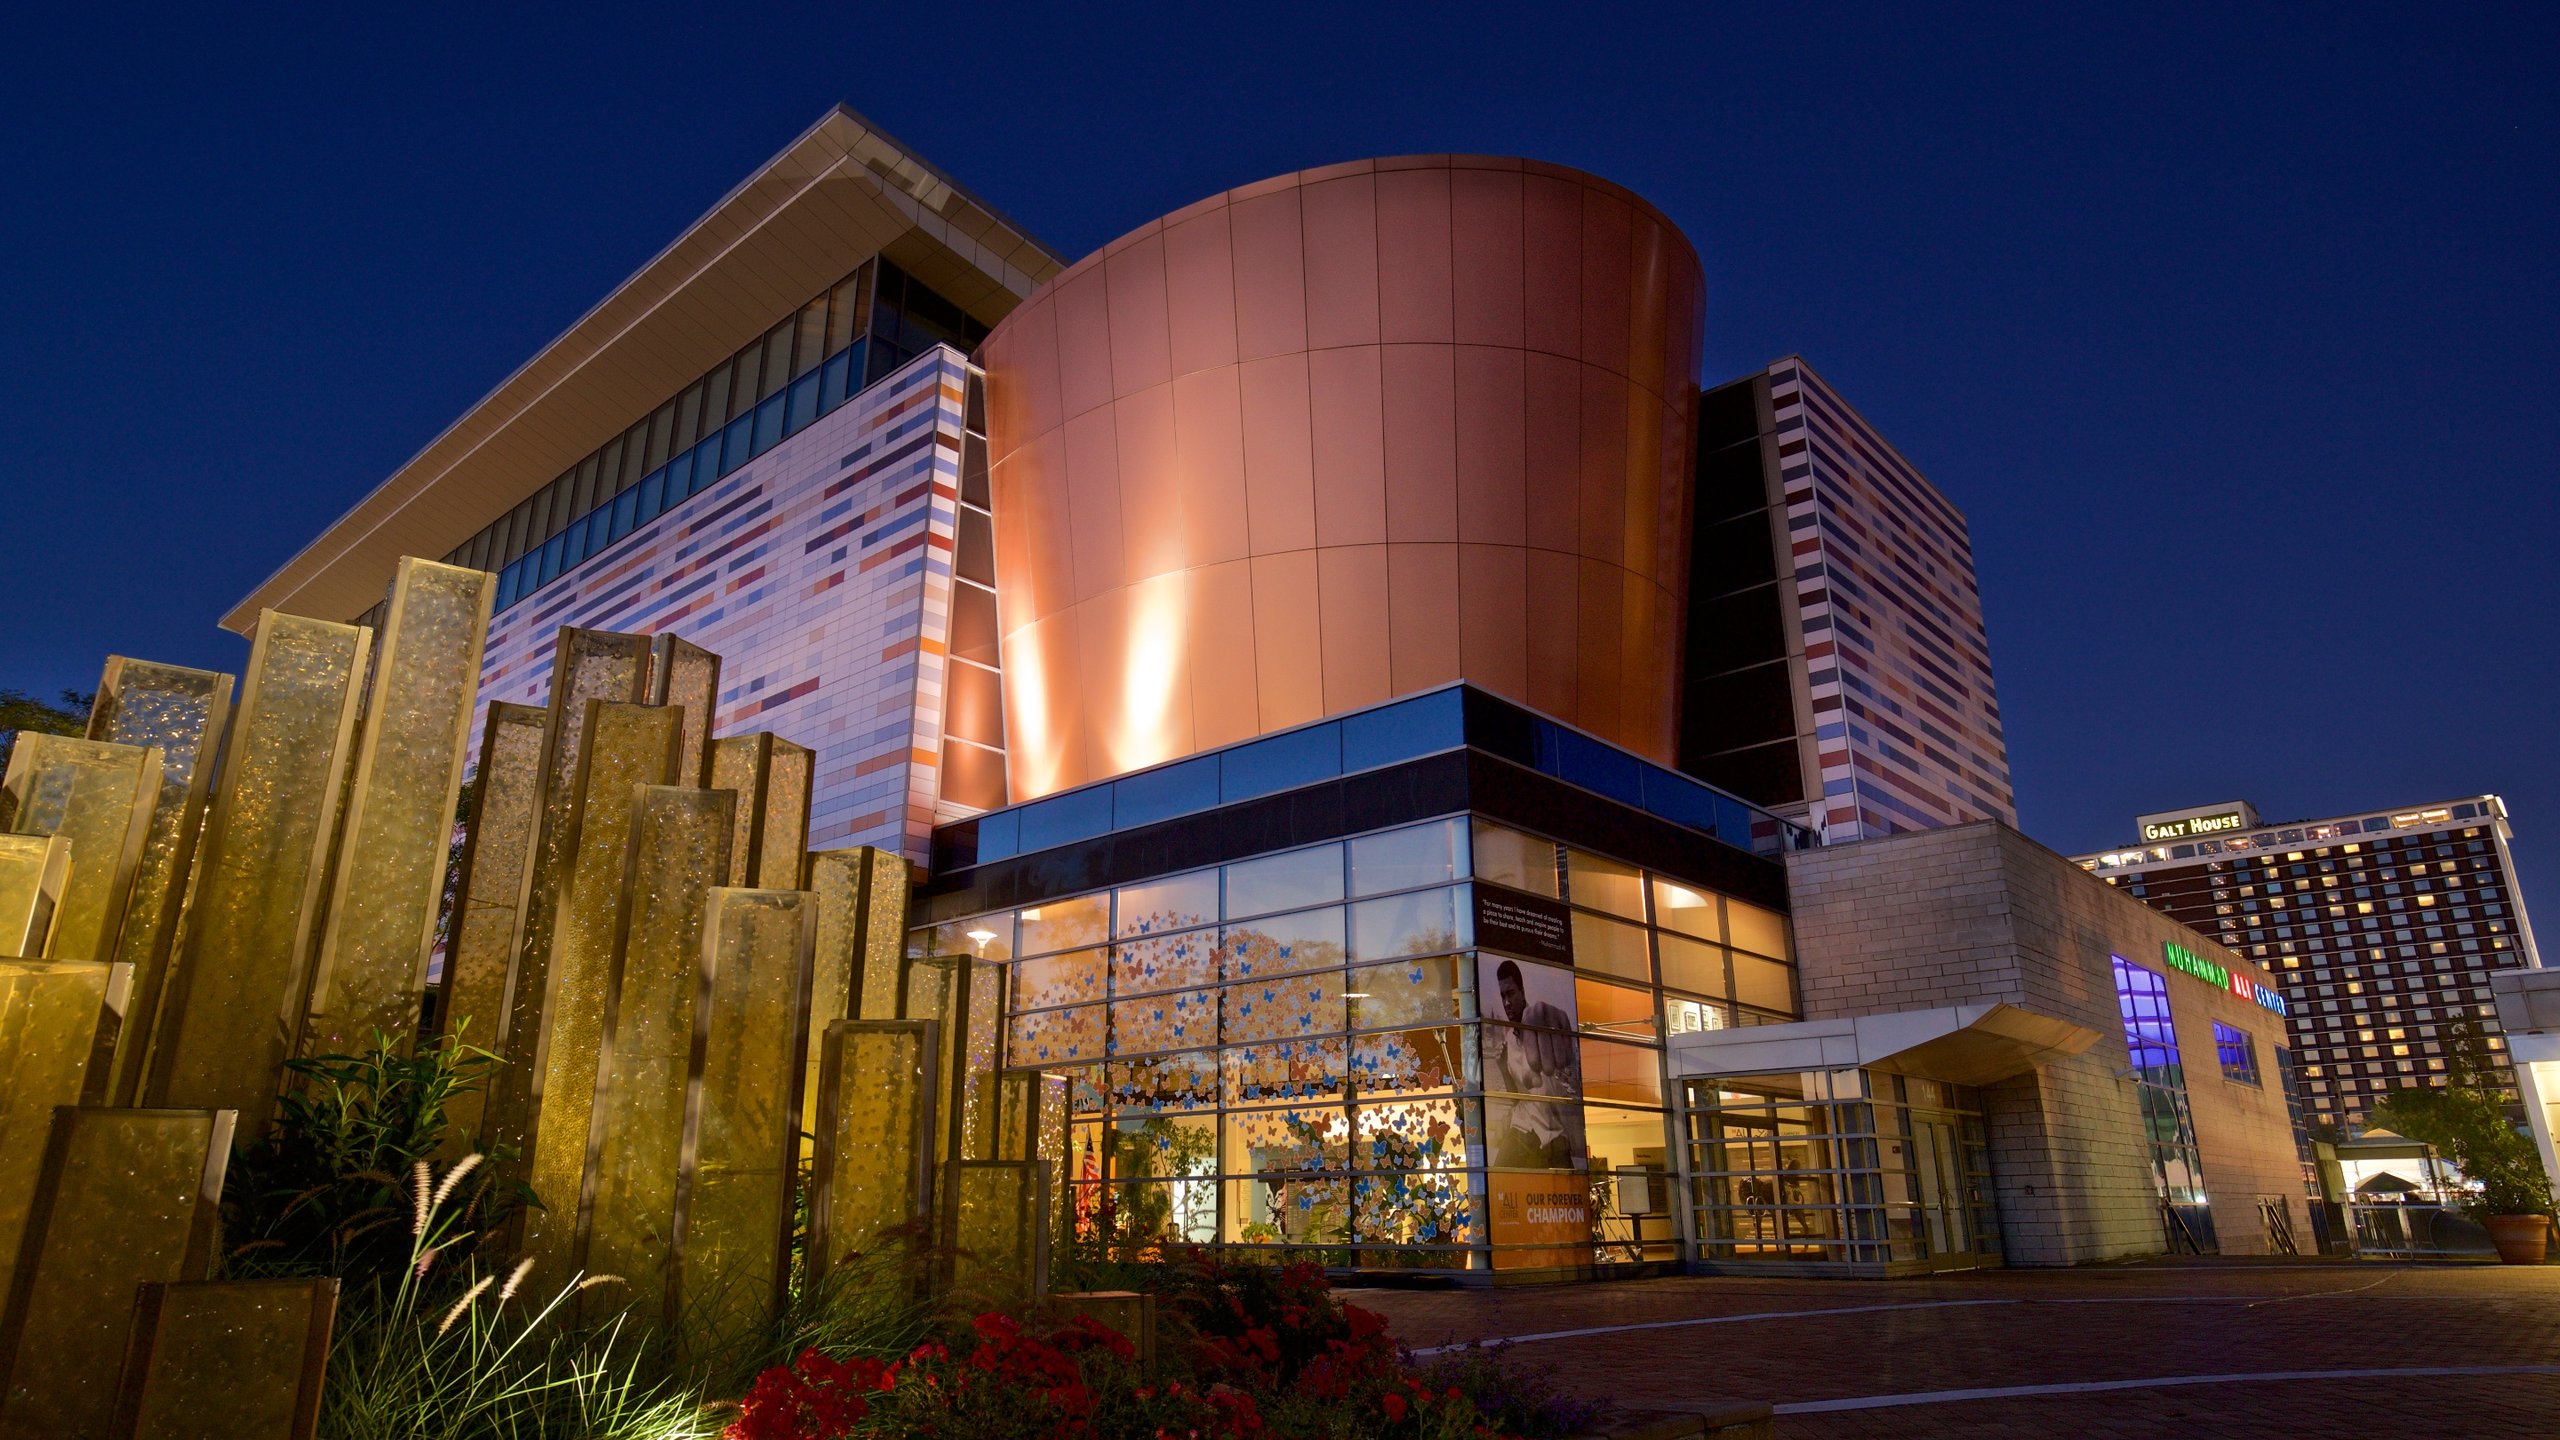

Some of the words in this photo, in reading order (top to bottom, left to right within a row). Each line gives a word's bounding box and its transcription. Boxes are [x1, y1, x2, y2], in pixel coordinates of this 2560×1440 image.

[2145, 823, 2185, 840] GALT
[2189, 815, 2240, 834] HOUSE
[2166, 940, 2229, 990] MUHAMMAD
[2232, 972, 2253, 1000] ALI
[2254, 983, 2287, 1017] CENTER
[1920, 1083, 1936, 1104] 144
[1526, 1193, 1545, 1206] OUR
[1547, 1193, 1583, 1206] FOREVER
[1527, 1207, 1585, 1224] CHAMPION
